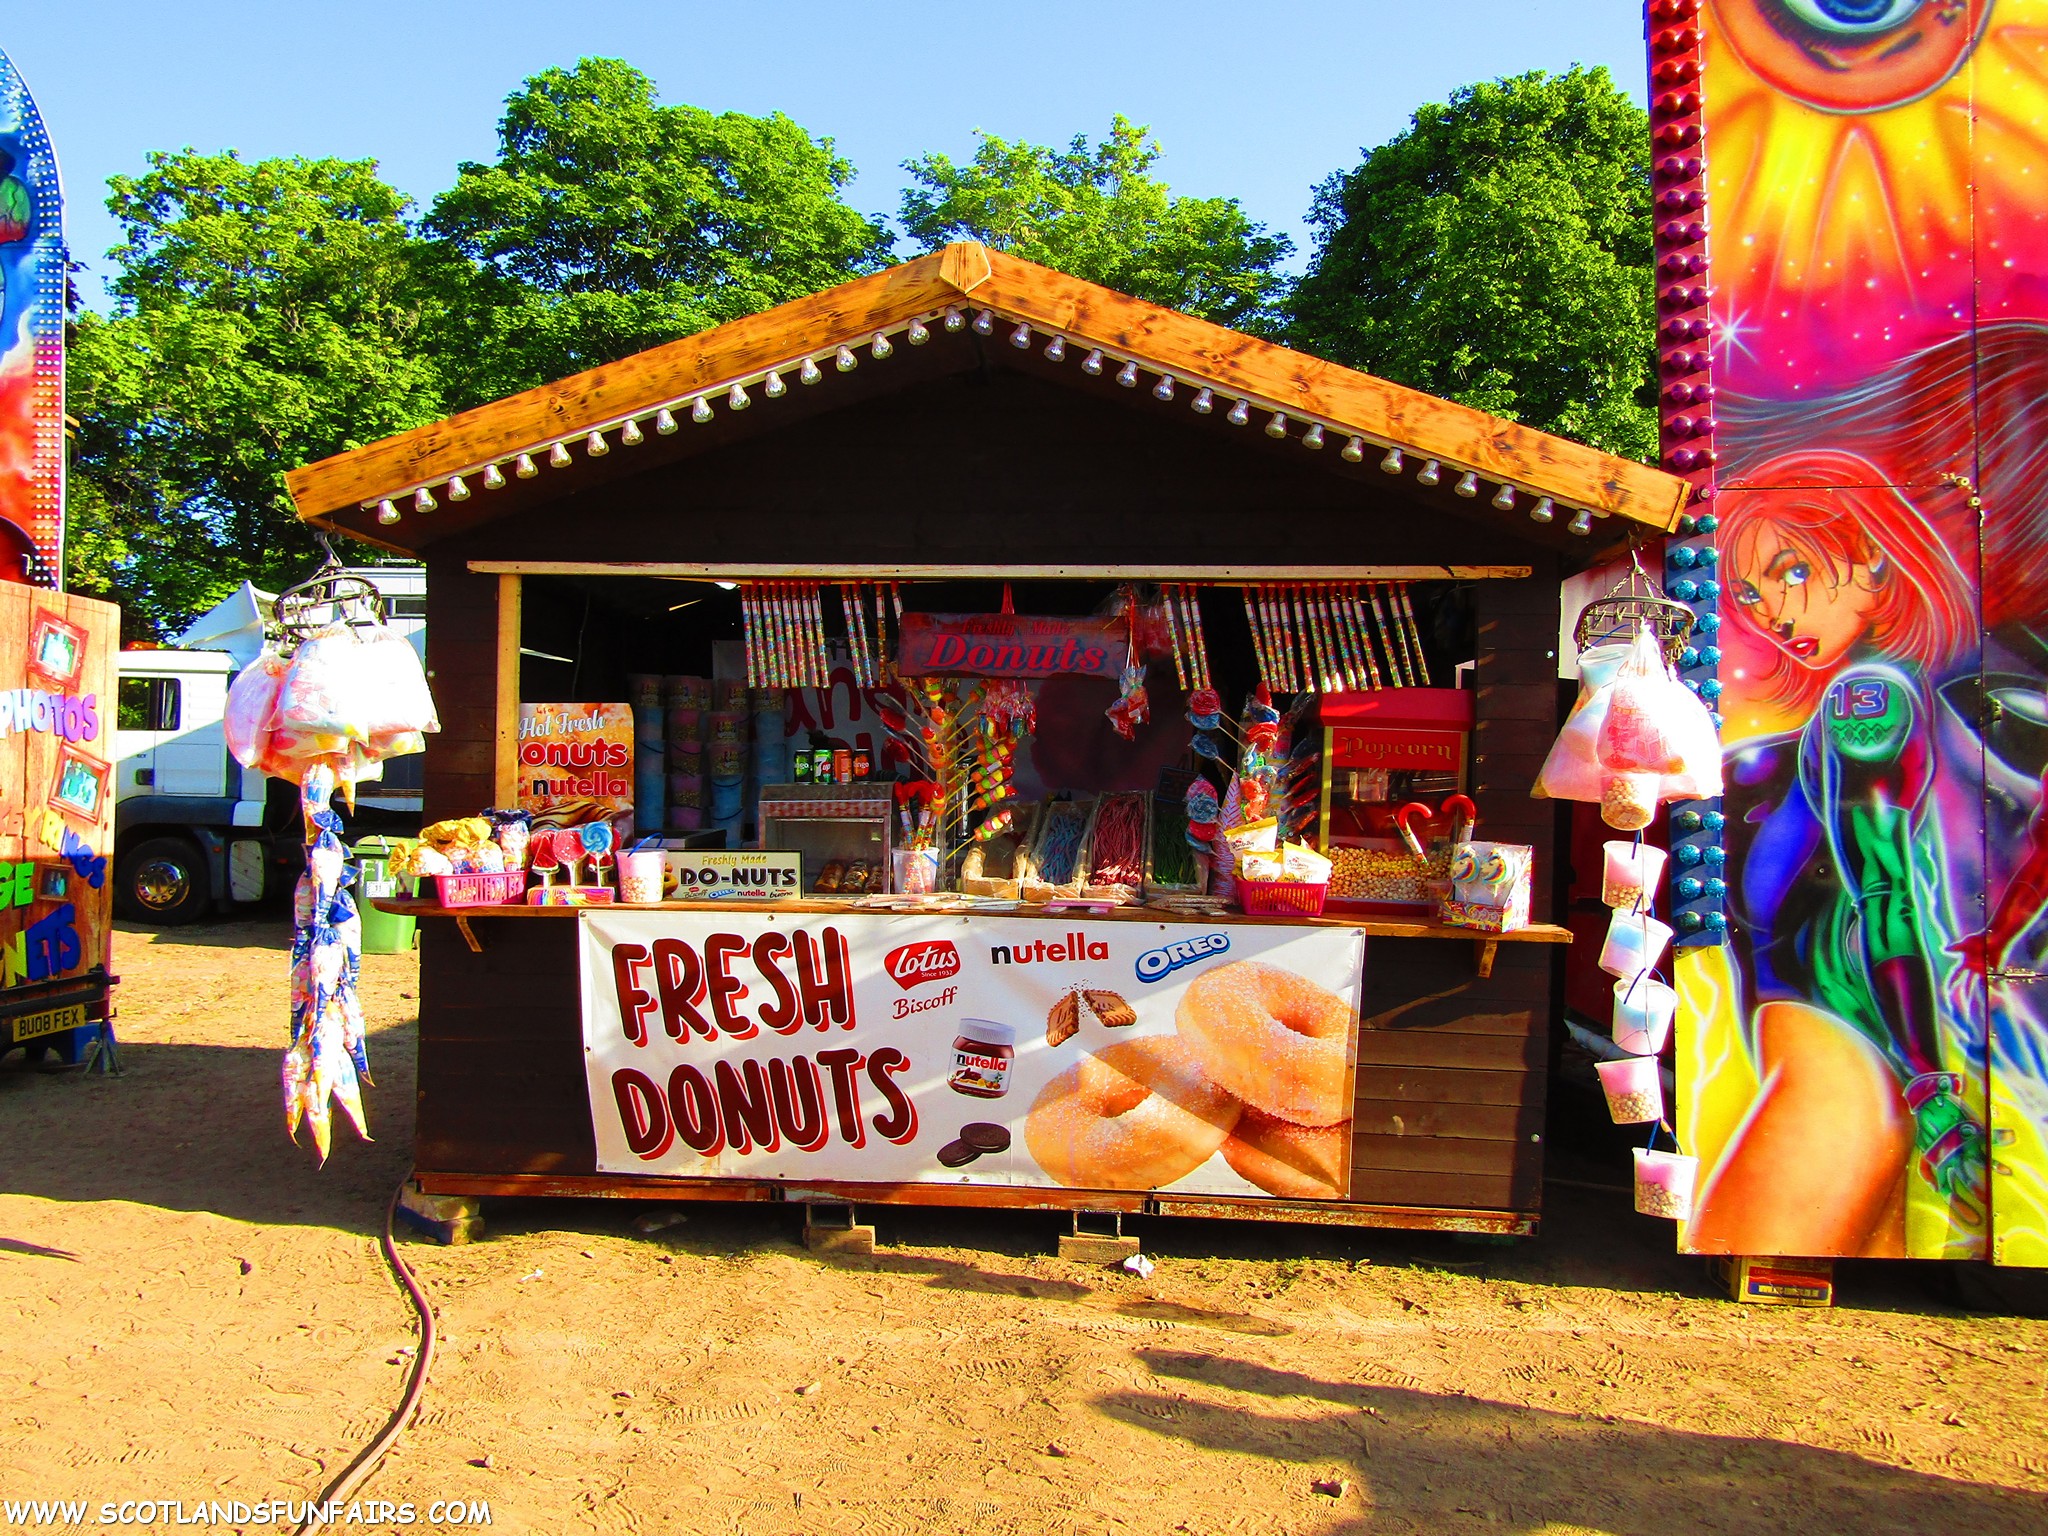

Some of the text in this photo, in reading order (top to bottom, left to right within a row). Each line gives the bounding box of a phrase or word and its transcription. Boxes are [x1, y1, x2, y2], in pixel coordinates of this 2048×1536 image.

[961, 619, 1071, 637] Freshly Made
[923, 633, 1108, 671] Donuts
[1828, 681, 1888, 719] 13
[519, 709, 605, 741] Hot Fresh
[518, 738, 628, 768] onuts
[1341, 736, 1452, 760] Popcorn
[532, 771, 627, 797] nutella
[702, 853, 767, 867] Freshly Made
[680, 867, 797, 887] DO-NUTS
[737, 889, 766, 897] nutella
[0, 902, 81, 989] NETS
[991, 932, 1109, 965] nutella
[1136, 933, 1229, 979] OREO
[894, 946, 957, 978] Lotus
[611, 926, 856, 1047] FRESH
[892, 985, 958, 1020] Biscoff
[19, 1008, 79, 1037] BU08 FEX
[957, 1053, 1007, 1072] nutella
[611, 1047, 919, 1161] DONUTS
